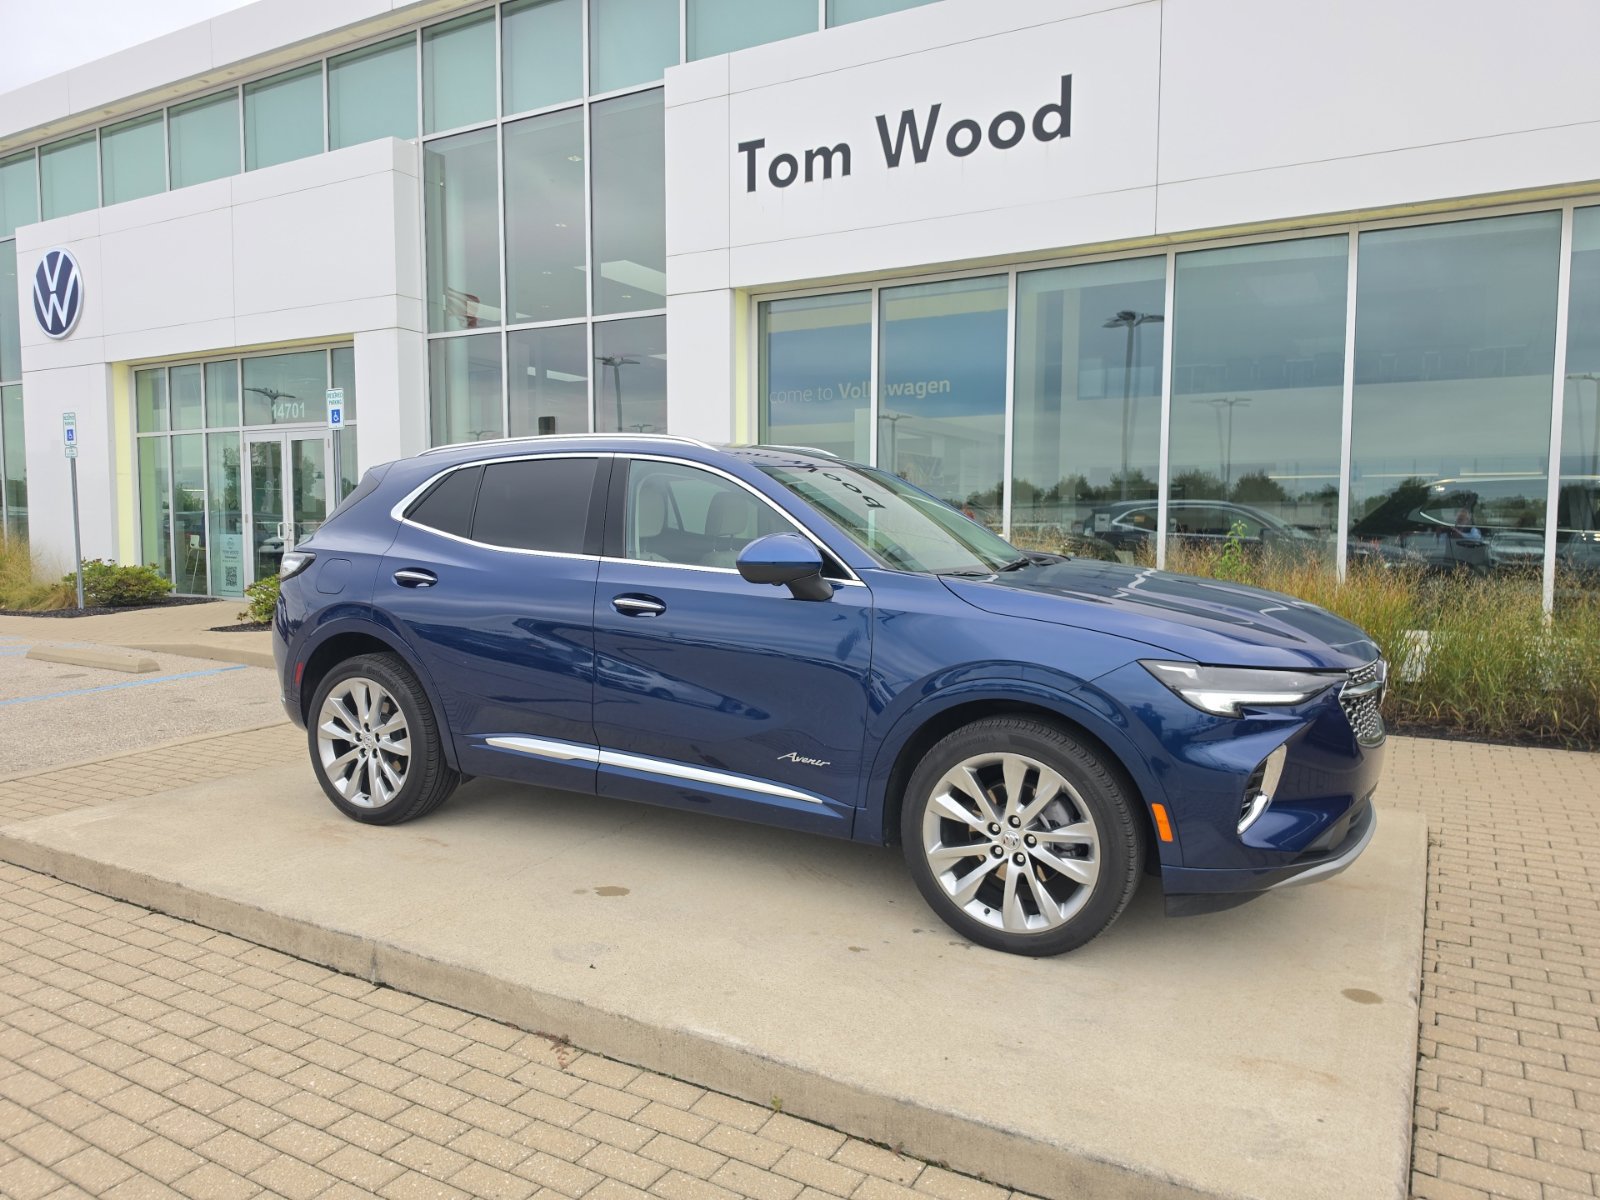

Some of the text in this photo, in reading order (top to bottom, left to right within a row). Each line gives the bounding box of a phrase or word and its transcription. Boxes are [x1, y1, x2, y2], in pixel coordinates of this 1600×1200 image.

[738, 73, 1073, 193] Tom Wood
[818, 384, 833, 401] to
[838, 379, 951, 399] Volwagen
[271, 402, 305, 419] 14701
[777, 751, 831, 767] Avenir
